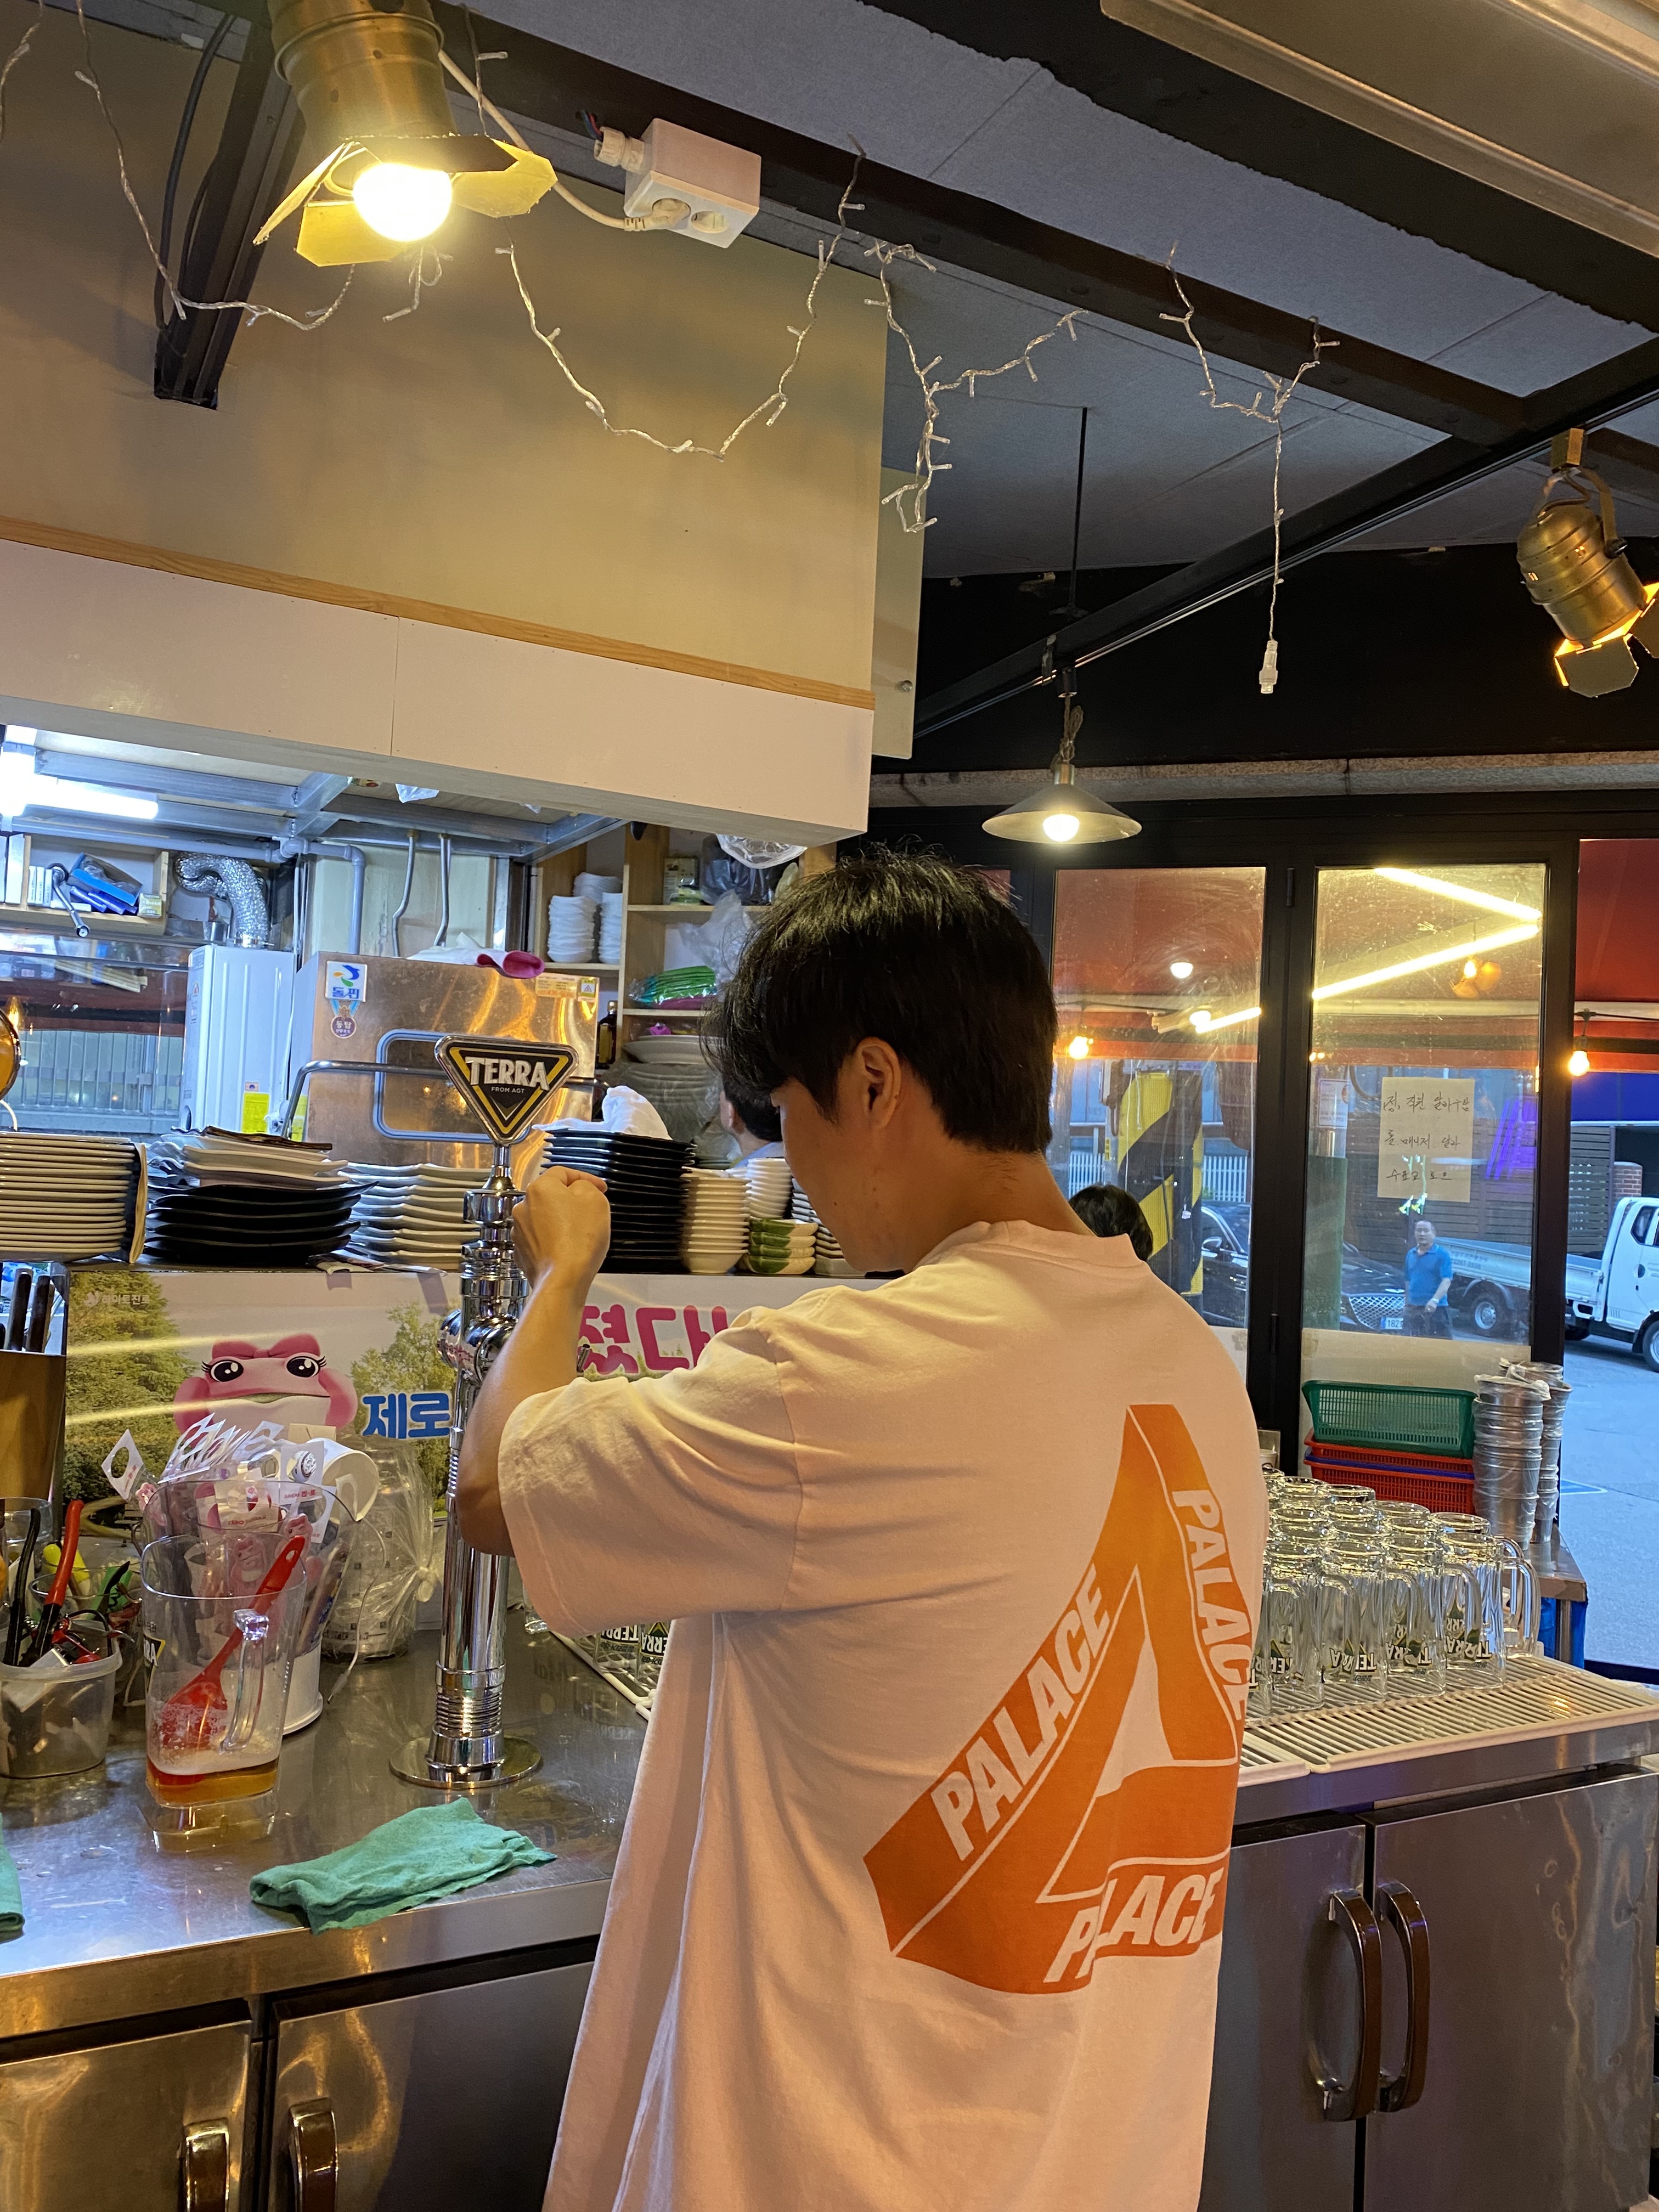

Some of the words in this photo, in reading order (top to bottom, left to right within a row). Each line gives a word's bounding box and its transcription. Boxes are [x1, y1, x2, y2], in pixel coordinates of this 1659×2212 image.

[332, 986, 359, 999] 돌핀
[465, 1056, 550, 1091] TERRA
[1401, 1133, 1430, 1150] 매니저
[101, 1294, 150, 1306] 하이트진로
[362, 1392, 450, 1440] 제로
[601, 1624, 639, 1641] TERR
[641, 1632, 668, 1655] ERRA
[930, 1562, 1110, 1861] PALACE
[1043, 1867, 1224, 1983] PLACE
